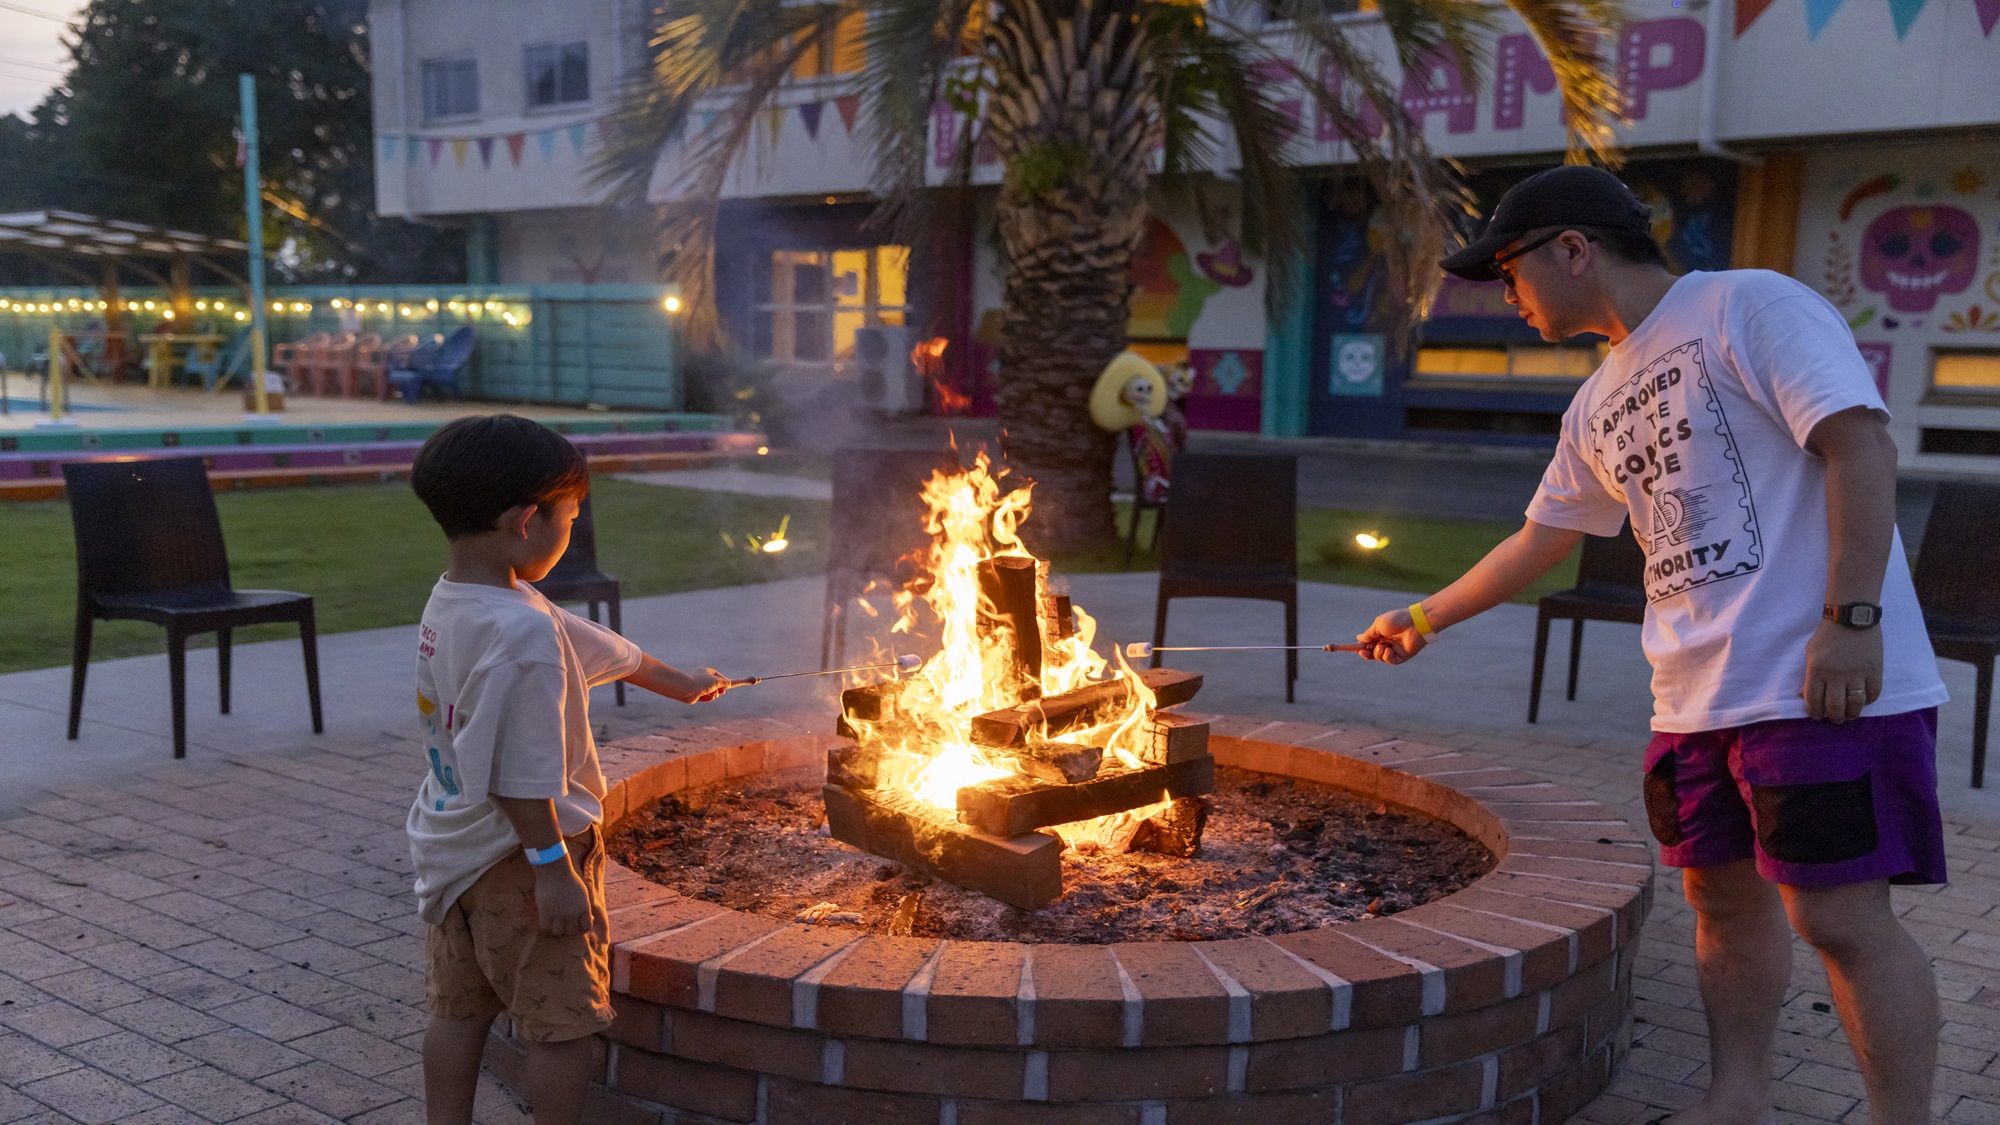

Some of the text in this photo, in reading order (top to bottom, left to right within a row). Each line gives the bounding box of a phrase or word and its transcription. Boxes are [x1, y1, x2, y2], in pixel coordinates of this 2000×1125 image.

[1603, 367, 1681, 438] APPROVED
[1616, 401, 1670, 451] BY TE
[1614, 418, 1692, 484] COMCS
[1646, 539, 1731, 587] THORITY
